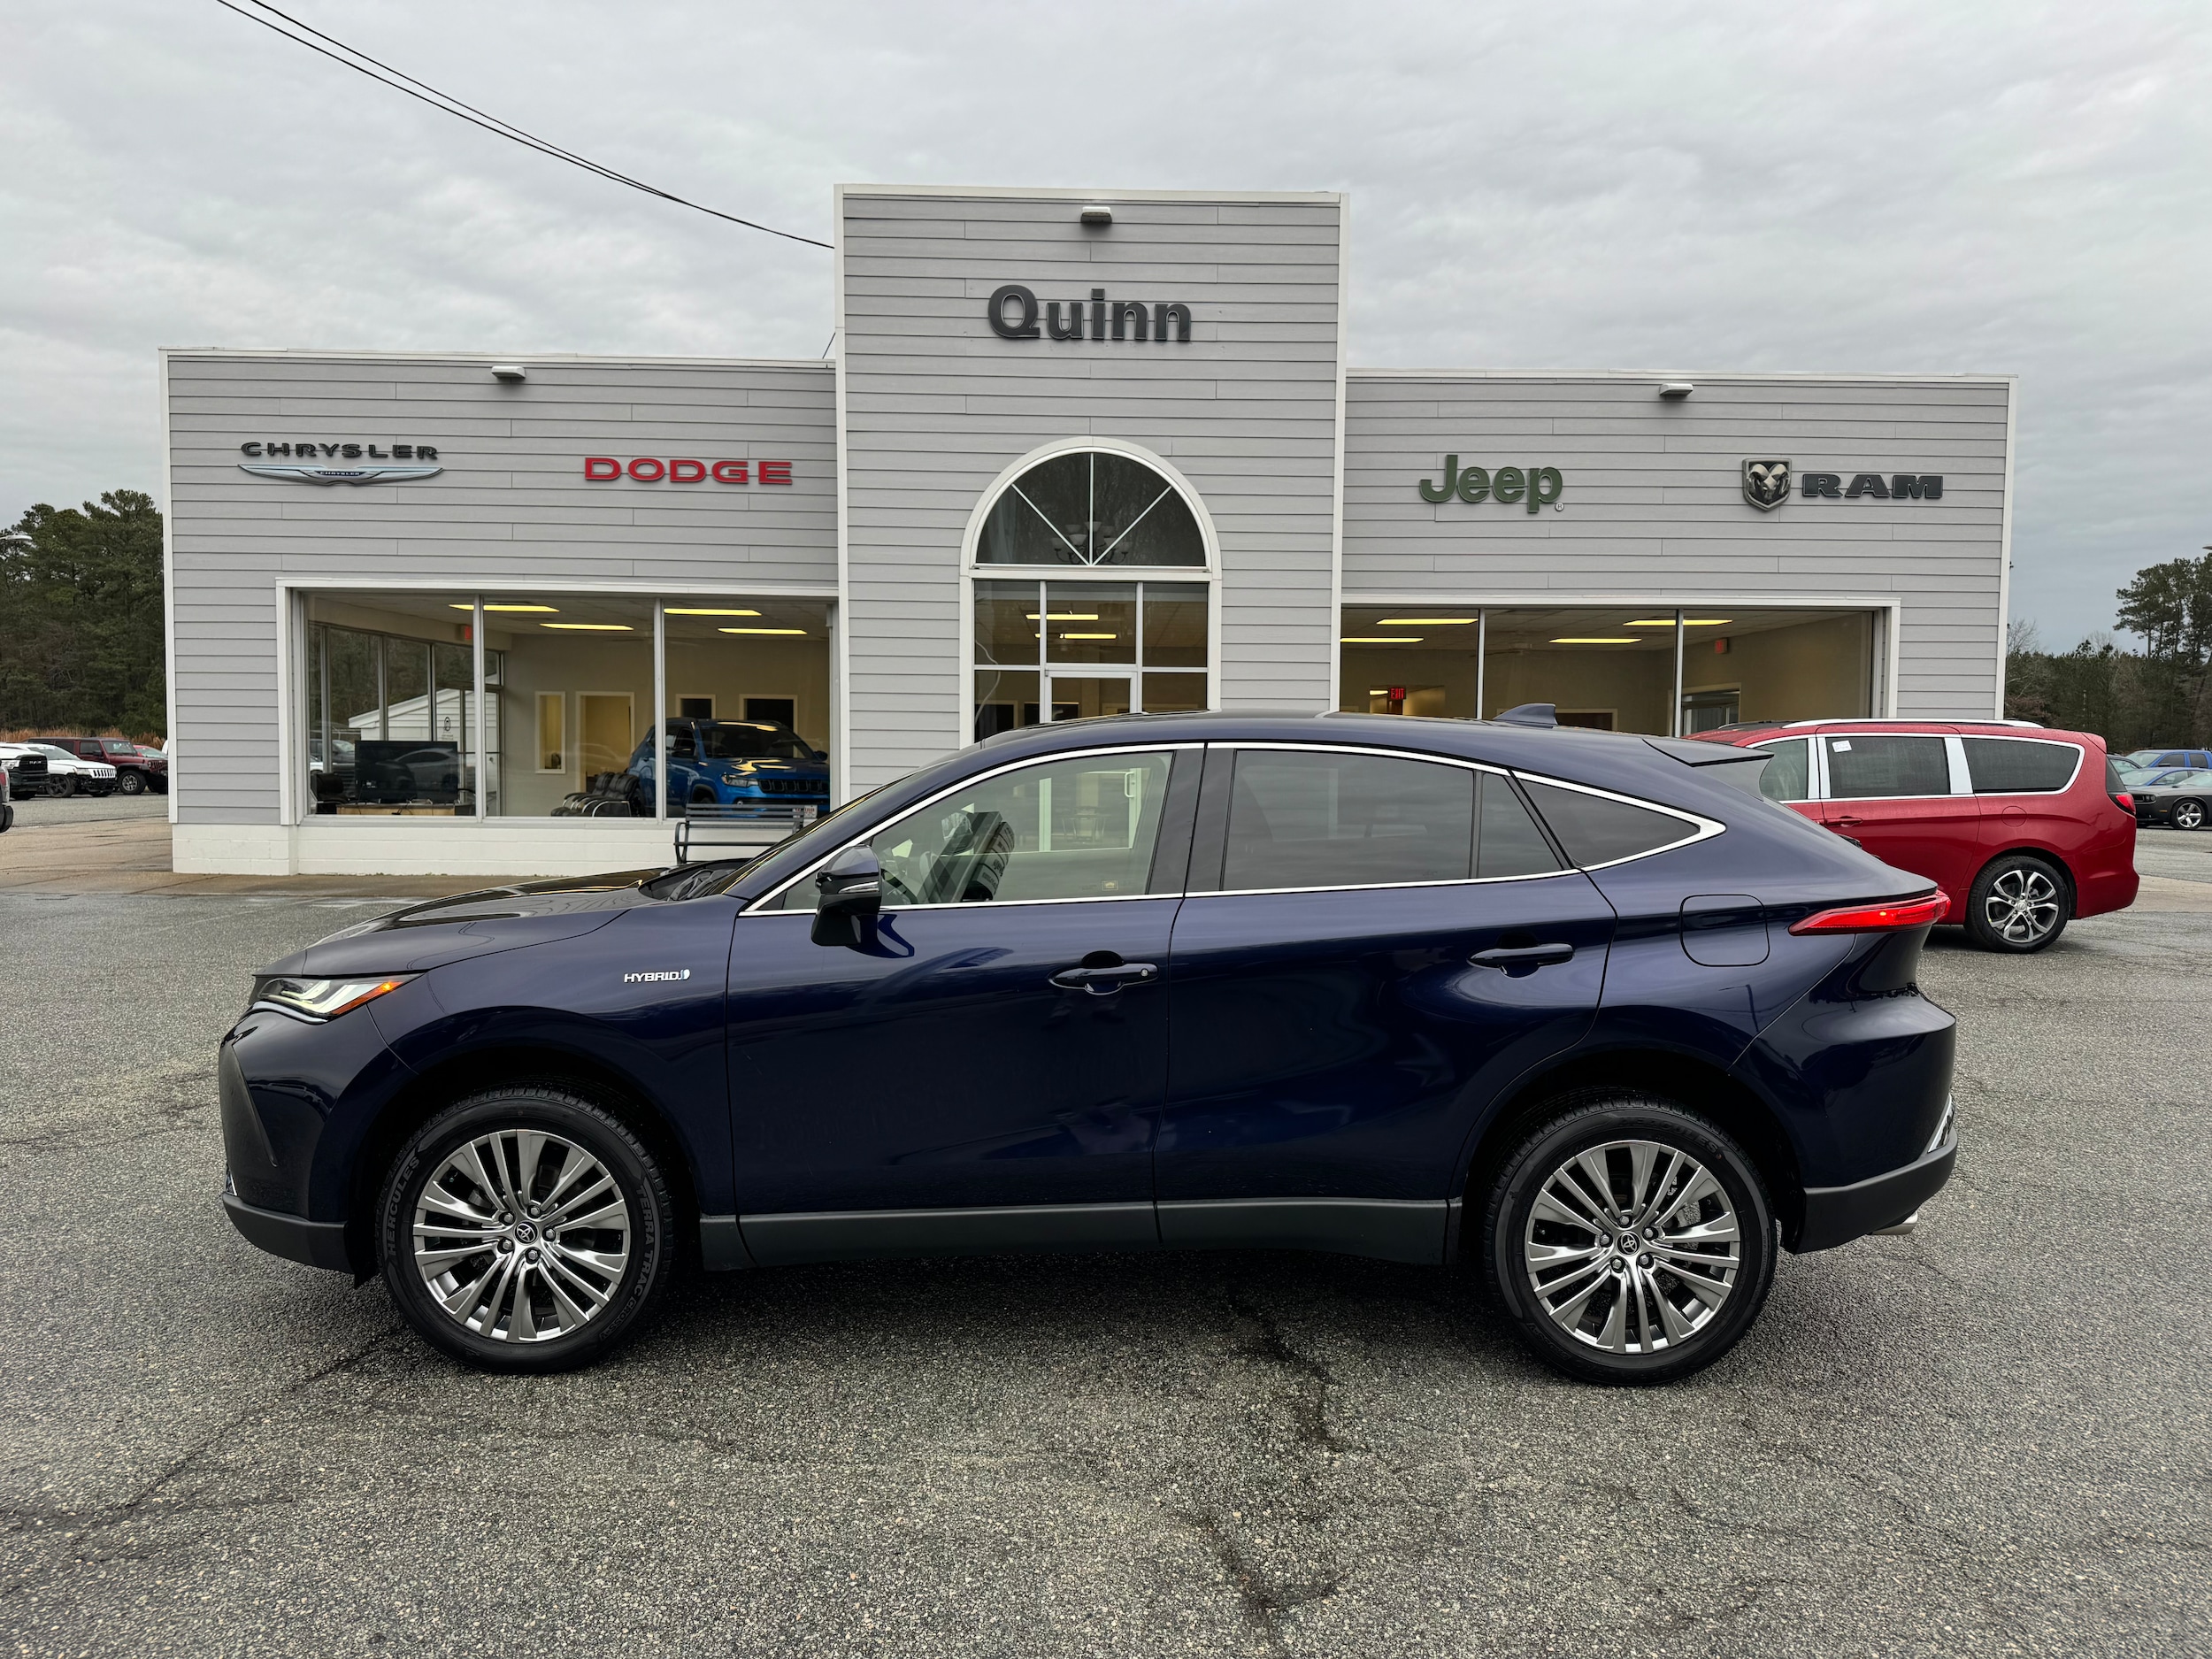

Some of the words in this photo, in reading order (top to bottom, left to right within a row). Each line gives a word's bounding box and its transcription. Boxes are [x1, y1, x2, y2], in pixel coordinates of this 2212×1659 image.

[987, 284, 1191, 342] Quinn
[241, 442, 438, 460] CHRYSLER
[585, 457, 793, 485] DODGE
[1419, 454, 1563, 513] Jeep
[1802, 473, 1944, 499] RAM
[1390, 687, 1405, 700] EXIT
[624, 971, 680, 983] HYBRID
[387, 1156, 420, 1256] HERCULES
[636, 1185, 654, 1245] TERRA
[634, 1249, 654, 1297] TRAC
